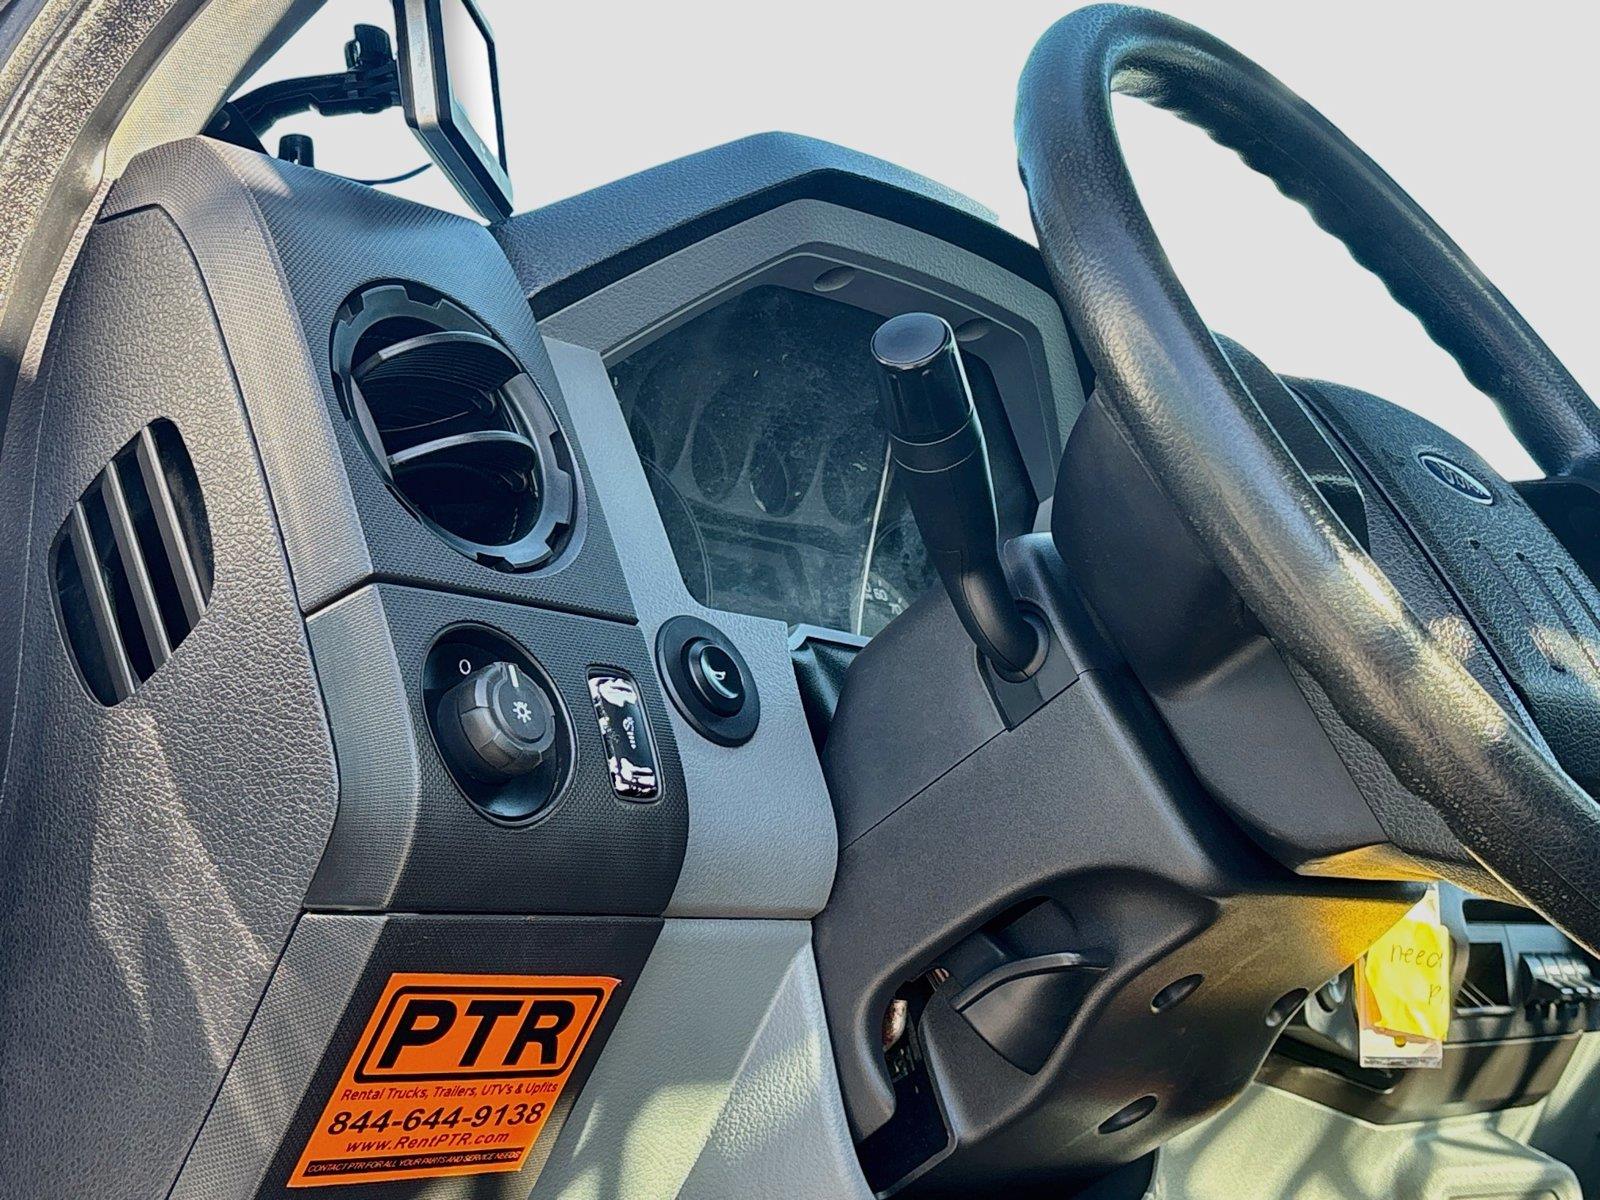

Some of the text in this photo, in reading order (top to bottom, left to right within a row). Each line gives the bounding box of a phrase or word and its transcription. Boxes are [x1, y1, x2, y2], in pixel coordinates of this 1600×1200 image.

[376, 999, 576, 1069] PTR
[340, 1081, 559, 1102] Rental Trucks, Trailers, UTV's & Upfits
[328, 1101, 546, 1136] 844-644-9138
[345, 1131, 510, 1153] www.RentPTR.com
[307, 1163, 347, 1173] CONTACT
[347, 1161, 367, 1171] PTR
[365, 1160, 385, 1170] FOR
[383, 1159, 398, 1168] ALL
[399, 1157, 421, 1167] YOUR
[419, 1156, 448, 1165] PARTS
[446, 1155, 464, 1164] AND
[463, 1153, 495, 1162] SERVICE
